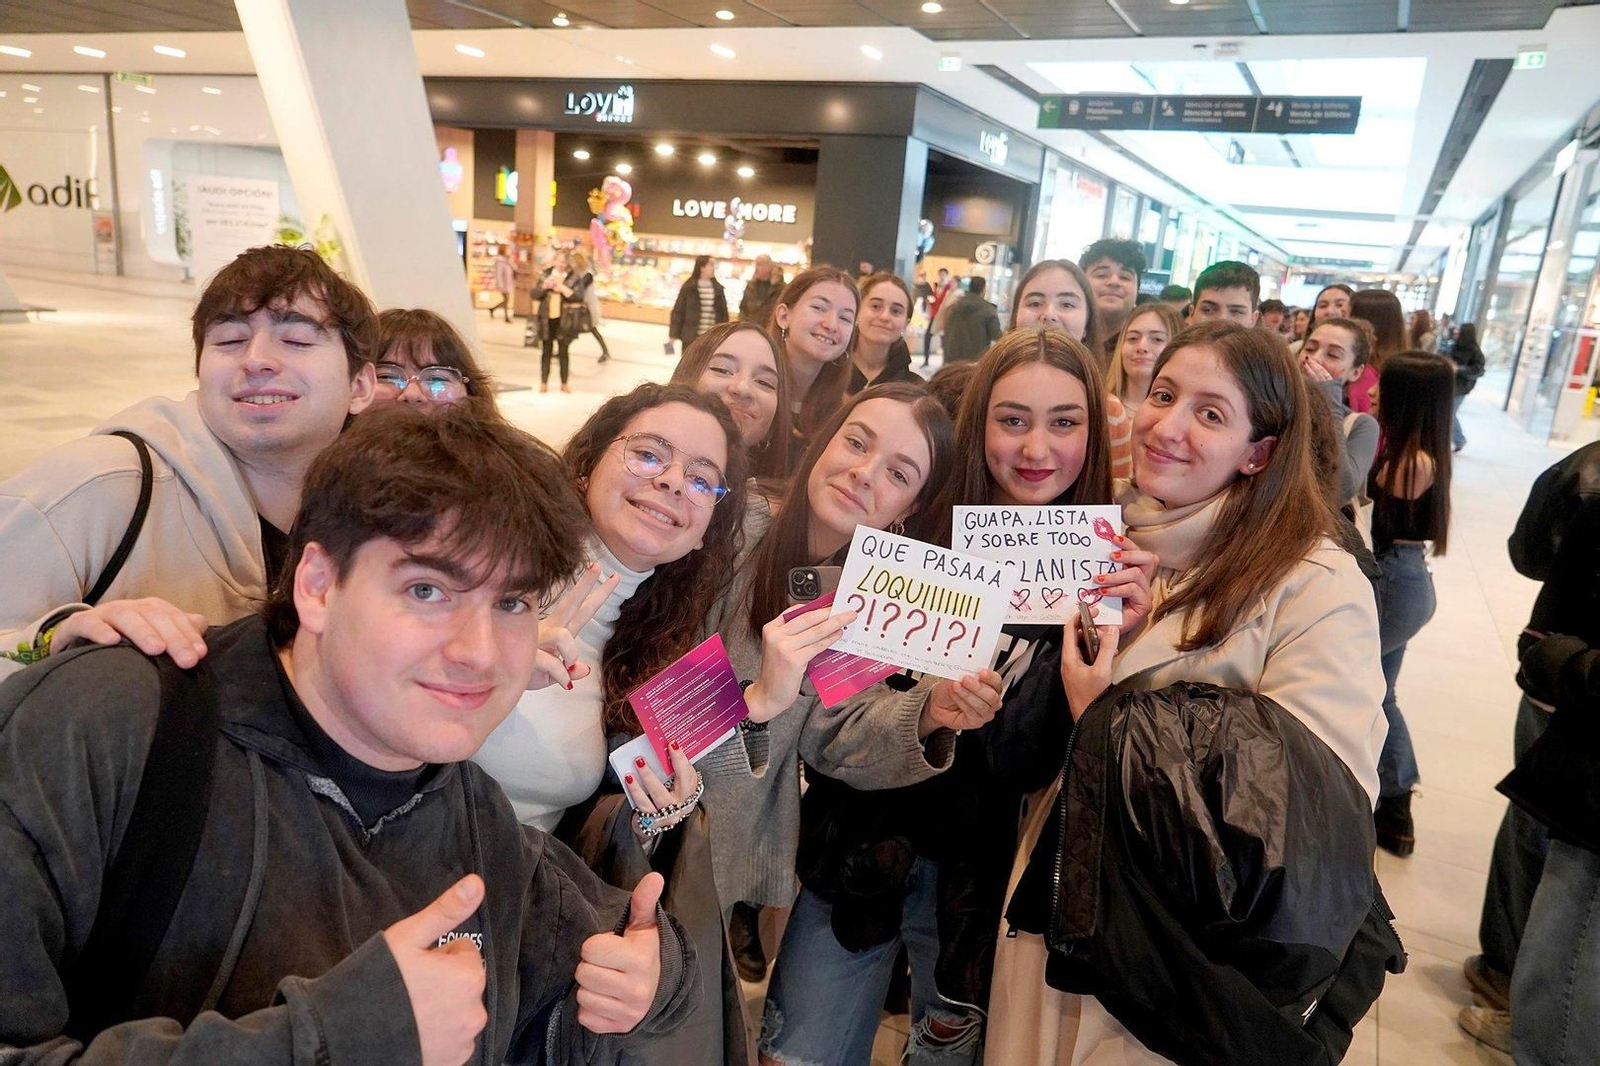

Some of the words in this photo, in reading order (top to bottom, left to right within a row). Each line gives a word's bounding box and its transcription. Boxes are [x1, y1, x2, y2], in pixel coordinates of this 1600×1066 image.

[27, 174, 98, 209] adif
[672, 199, 727, 219] LOVE
[736, 202, 797, 223] MORE
[1035, 509, 1089, 526] LISTA
[963, 534, 974, 549] Y
[981, 532, 1039, 549] SOBRE
[1047, 531, 1092, 547] TODO
[861, 535, 910, 562] QUE
[923, 549, 1001, 588] PASAAA
